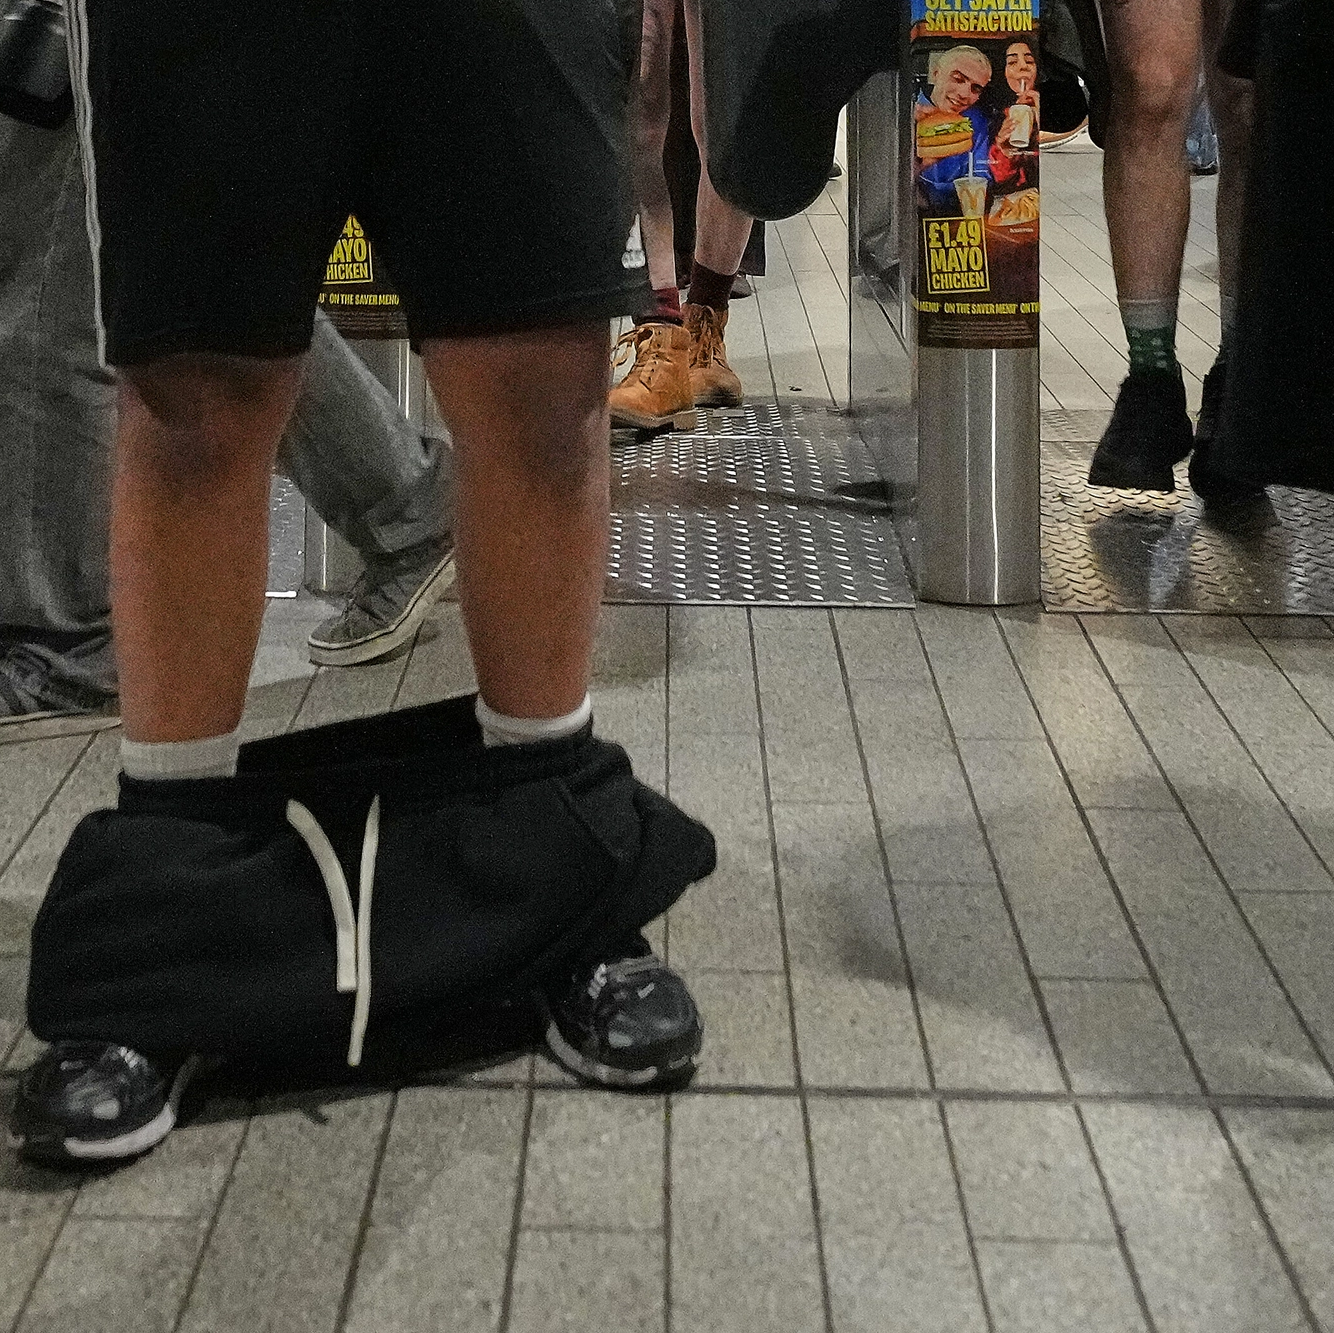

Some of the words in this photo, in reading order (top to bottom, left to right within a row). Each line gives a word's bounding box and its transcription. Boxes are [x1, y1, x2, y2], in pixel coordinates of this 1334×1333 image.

[925, 11, 1033, 32] SATISFACTION
[928, 220, 981, 248] £1.49
[930, 246, 984, 272] MAYO
[324, 263, 369, 280] HICKEN
[932, 271, 985, 289] CHICKEN
[329, 293, 340, 304] ON
[340, 293, 354, 305] THE
[355, 294, 378, 305] SAVER
